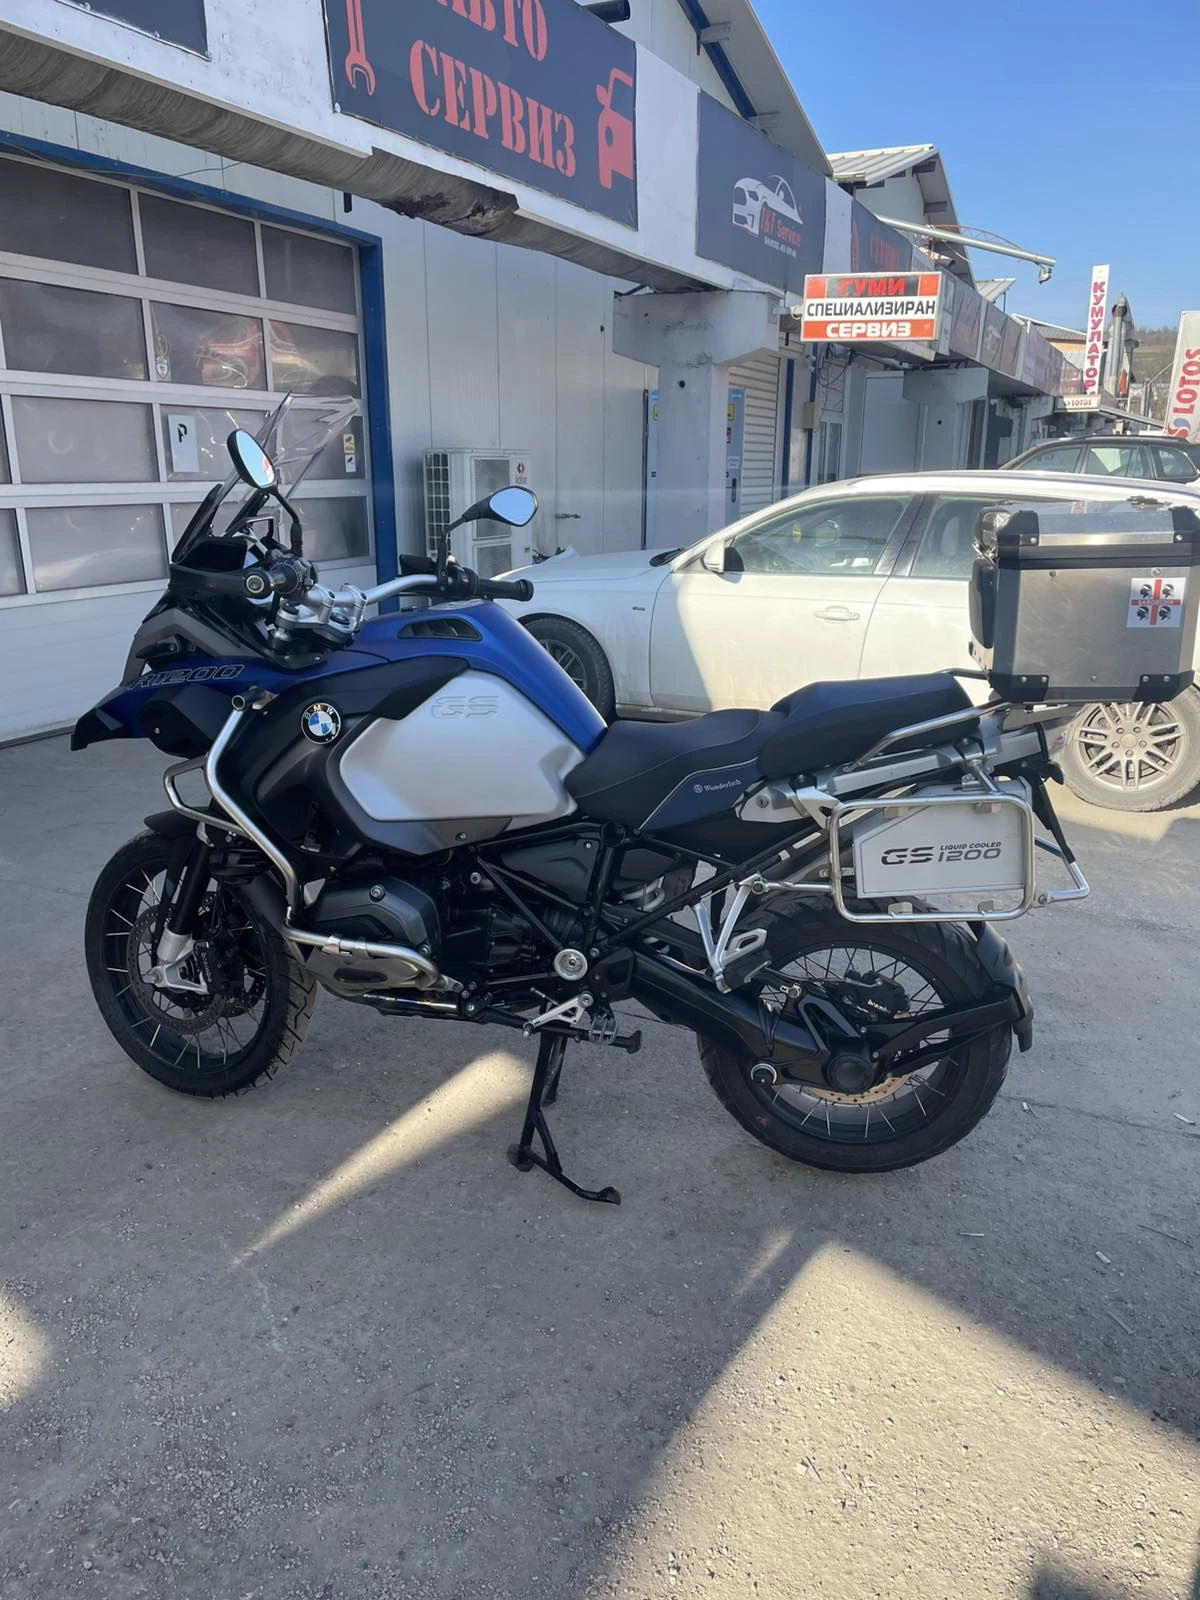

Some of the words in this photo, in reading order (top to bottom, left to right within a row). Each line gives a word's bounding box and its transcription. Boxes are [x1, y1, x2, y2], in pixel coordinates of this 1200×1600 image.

[437, 0, 548, 61] ТО
[409, 39, 576, 177] СЕРВИЗ
[838, 276, 905, 296] ГУМИ
[807, 300, 936, 316] СПЕЦИАЛИЗИРАН
[826, 321, 911, 338] СЕРВИЗ
[1173, 348, 1200, 414] LOTOS
[304, 704, 335, 719] BMW
[430, 695, 501, 720] GS
[704, 779, 742, 792] Wunderlich
[969, 841, 1001, 849] COOLED
[881, 846, 935, 866] GS
[938, 848, 1001, 862] 1200
